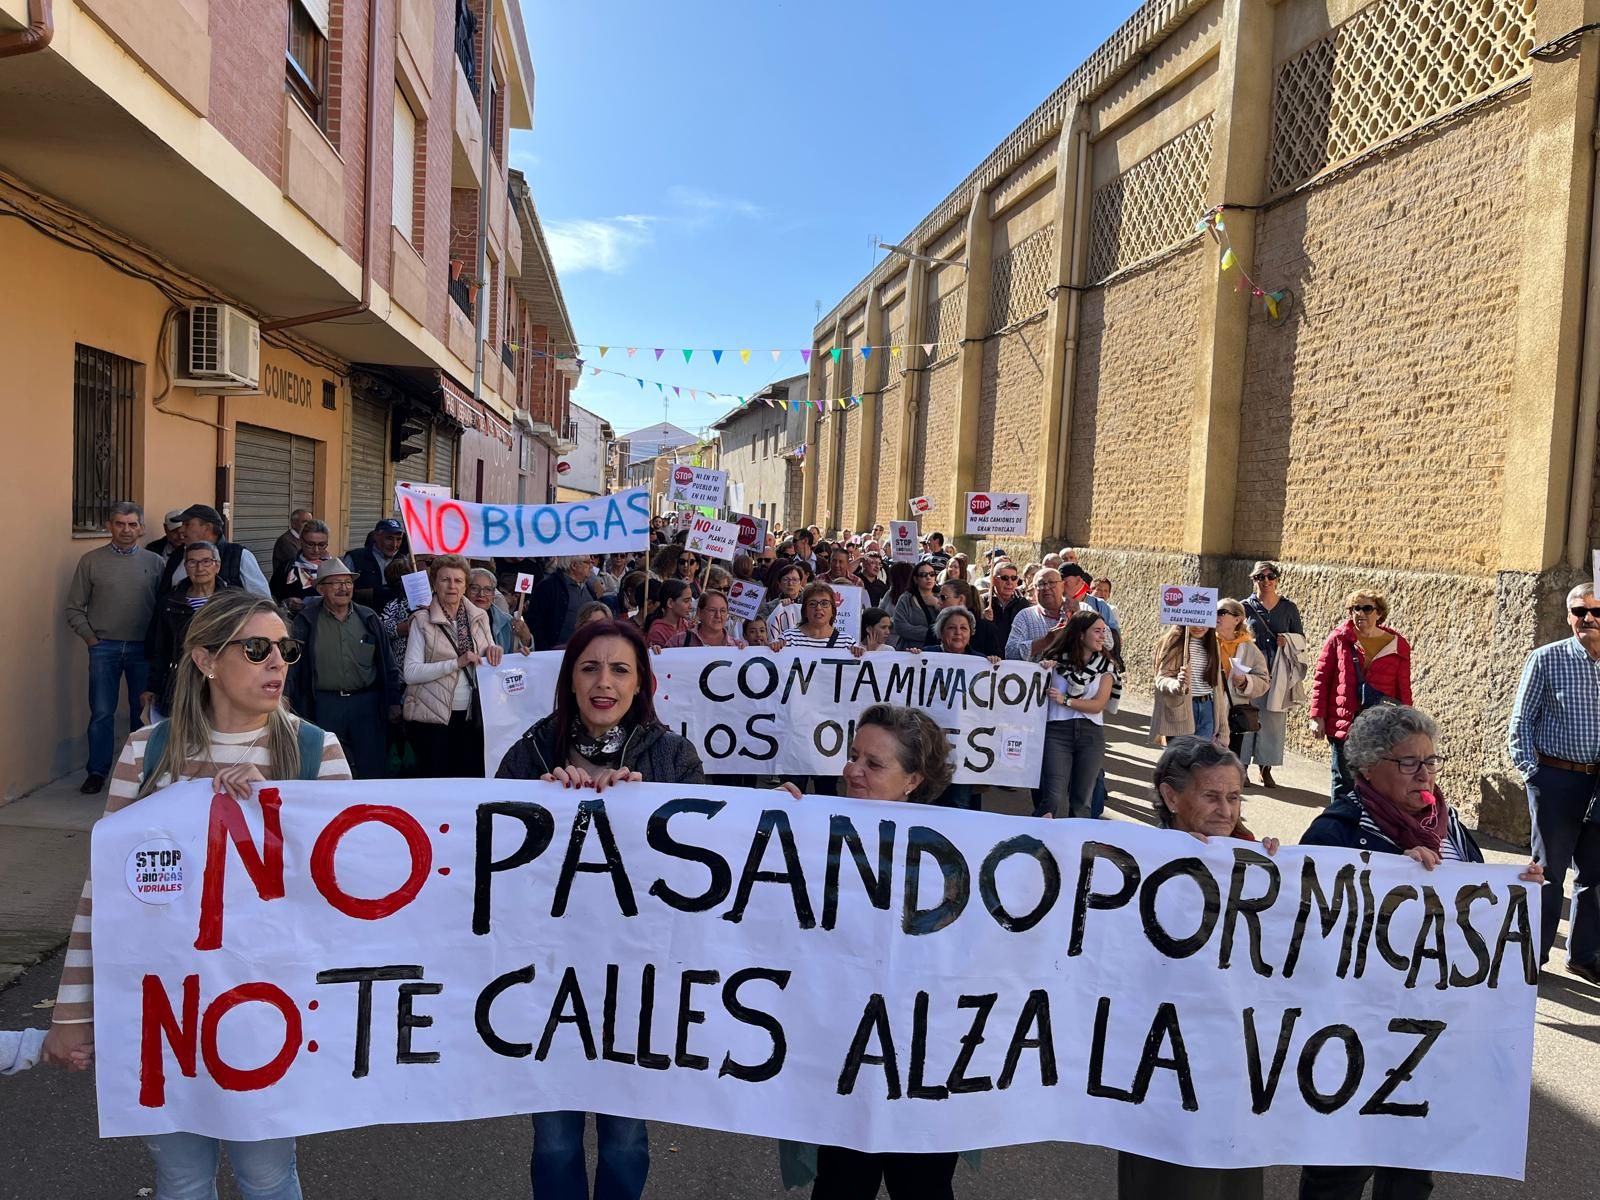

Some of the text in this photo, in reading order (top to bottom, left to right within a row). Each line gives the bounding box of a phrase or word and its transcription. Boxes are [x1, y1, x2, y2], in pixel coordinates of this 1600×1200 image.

[265, 363, 312, 408] COMEDOR
[675, 471, 693, 480] STOP
[692, 482, 712, 491] PUEBLO
[971, 500, 990, 509] STOP
[403, 491, 650, 554] NO BIOGAS
[694, 518, 712, 533] NO
[741, 525, 756, 536] TOP
[708, 535, 726, 543] PLANTA
[706, 544, 723, 552] BIOGAS
[1165, 592, 1182, 601] STOP
[1182, 608, 1206, 616] CAMIONES
[505, 674, 522, 684] STOP
[136, 850, 182, 868] STOP
[138, 883, 182, 893] VIDRIALES
[194, 787, 450, 950] NO:
[472, 798, 1061, 936] PASANDO
[1067, 840, 1280, 977] POR
[1375, 880, 1538, 990] CASA
[138, 963, 1447, 1118] NO: TE CALLES ALZA LA VOZ
